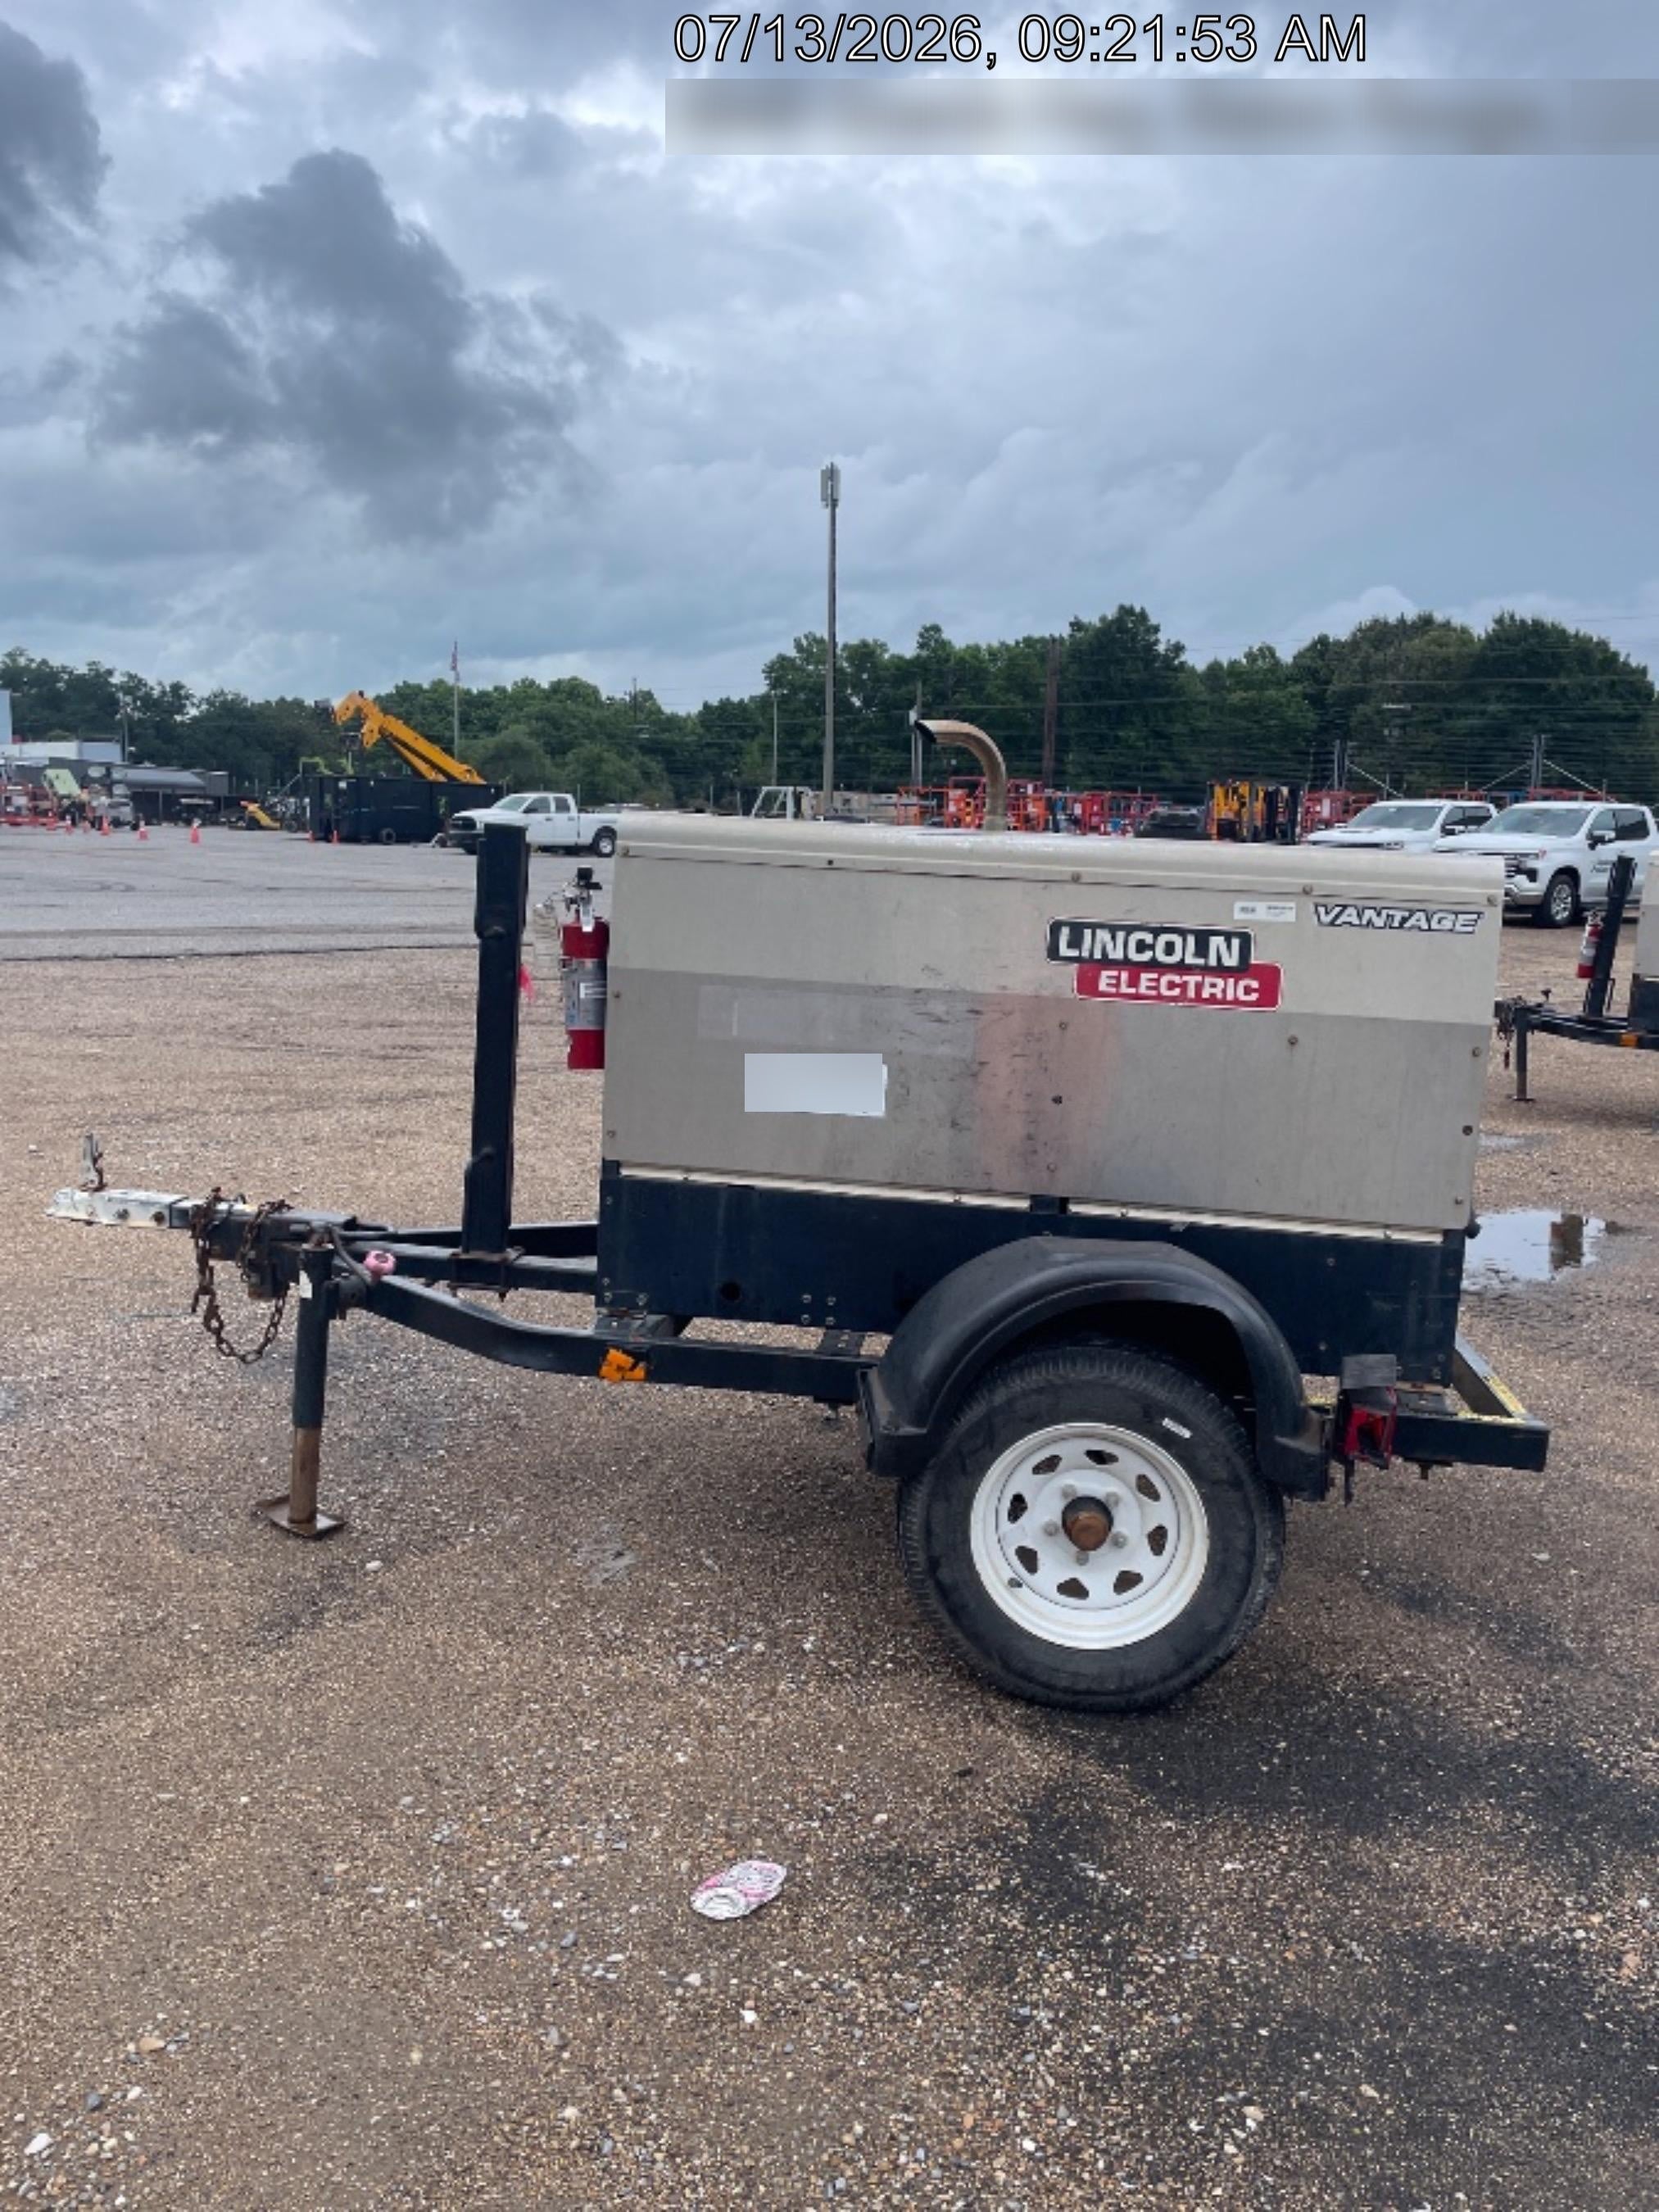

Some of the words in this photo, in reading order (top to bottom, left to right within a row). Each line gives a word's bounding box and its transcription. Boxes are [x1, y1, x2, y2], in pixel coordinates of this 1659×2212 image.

[1315, 904, 1480, 933] VANTAGE
[1058, 926, 1240, 968] LINCOLN
[1098, 970, 1260, 1001] ELECTRIC
